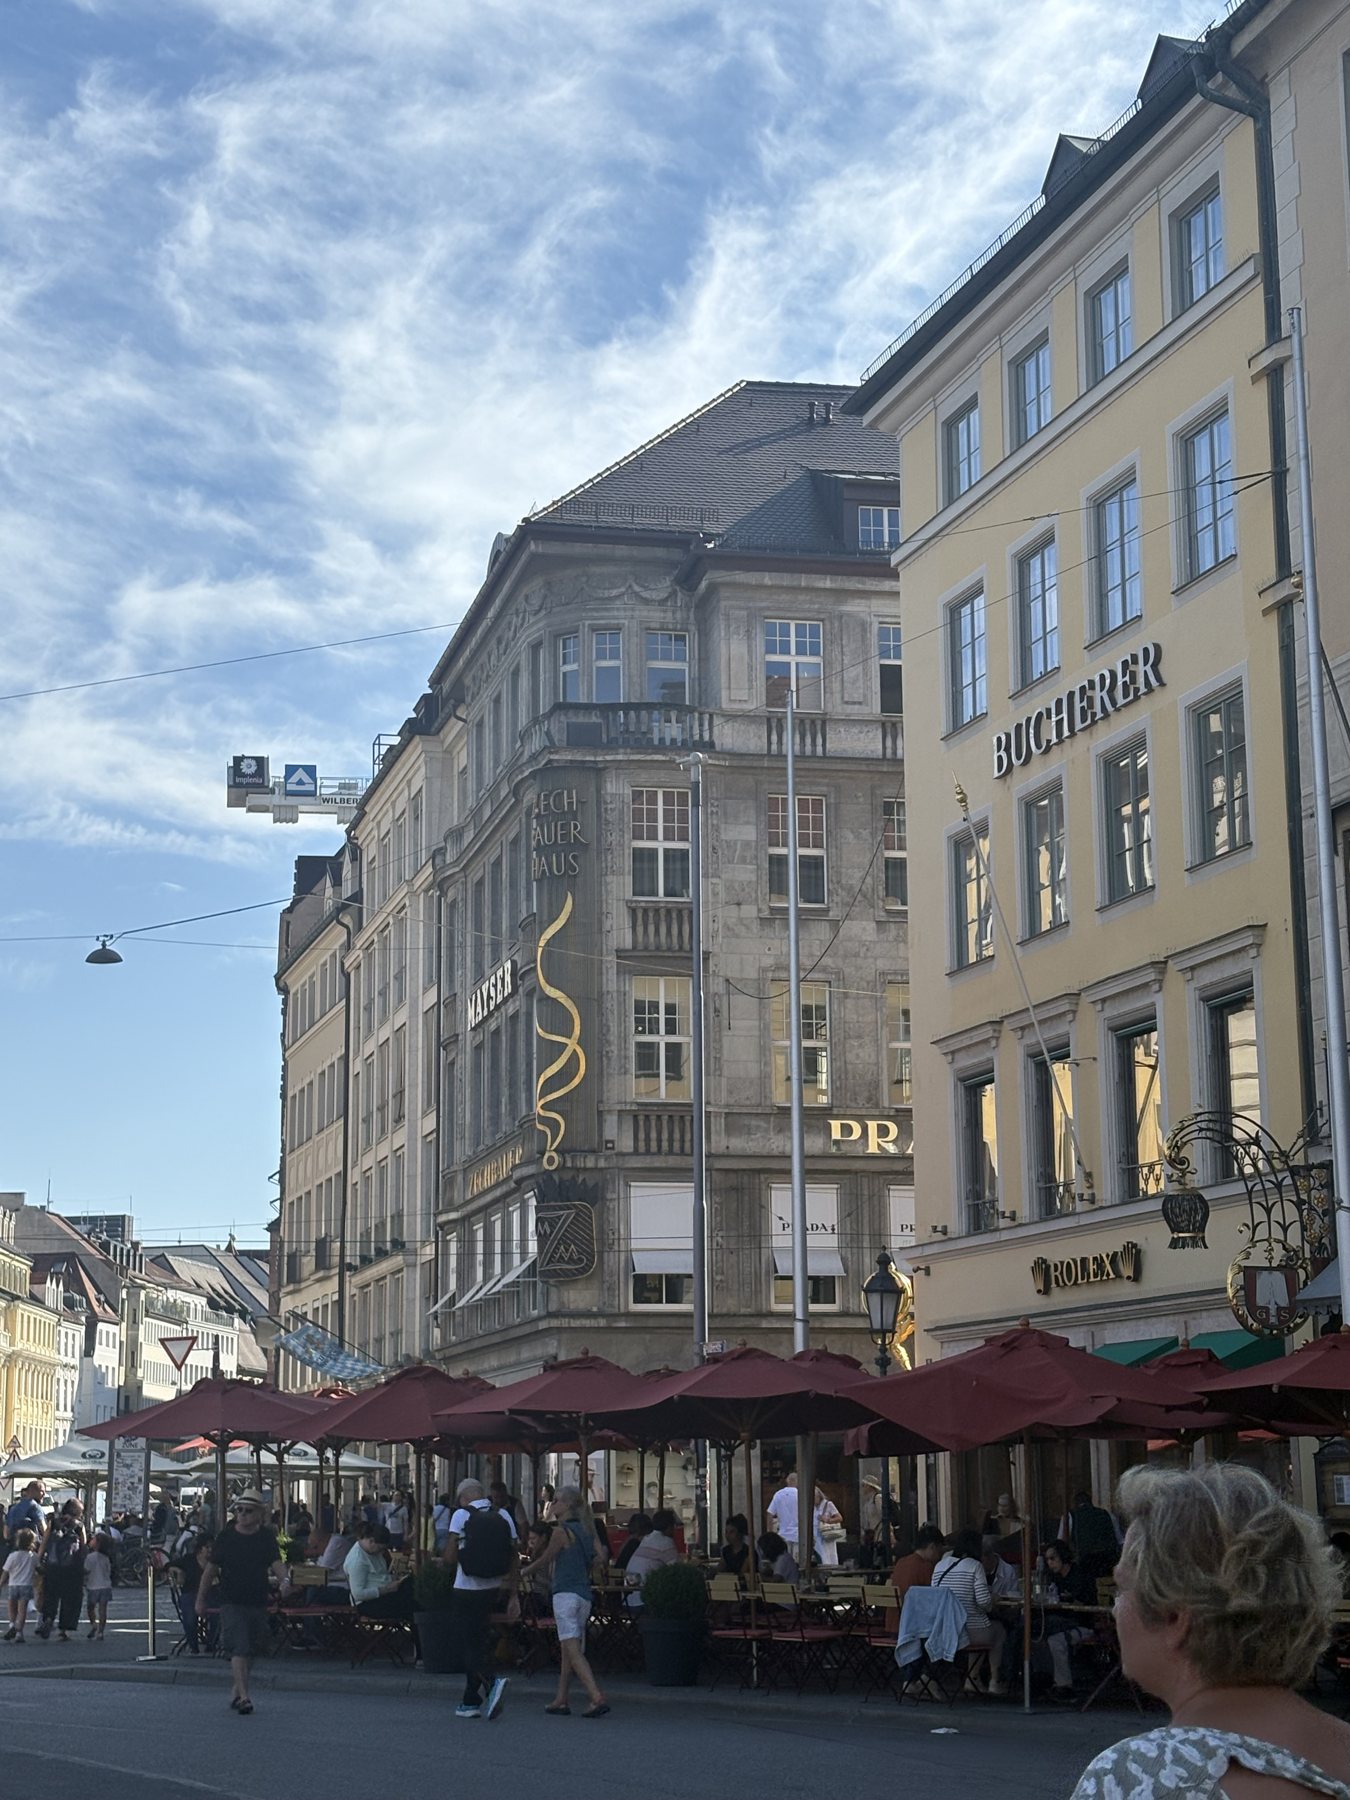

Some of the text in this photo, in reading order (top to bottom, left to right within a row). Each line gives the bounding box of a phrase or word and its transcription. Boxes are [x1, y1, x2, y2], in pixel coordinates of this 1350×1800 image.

[992, 642, 1166, 779] BUCHERER
[235, 776, 263, 784] Implenia
[321, 797, 361, 805] WILBER
[532, 852, 579, 880] HAUS
[467, 959, 512, 1031] MAYSER
[827, 1119, 914, 1154] PR
[1050, 1251, 1117, 1288] ROLEX
